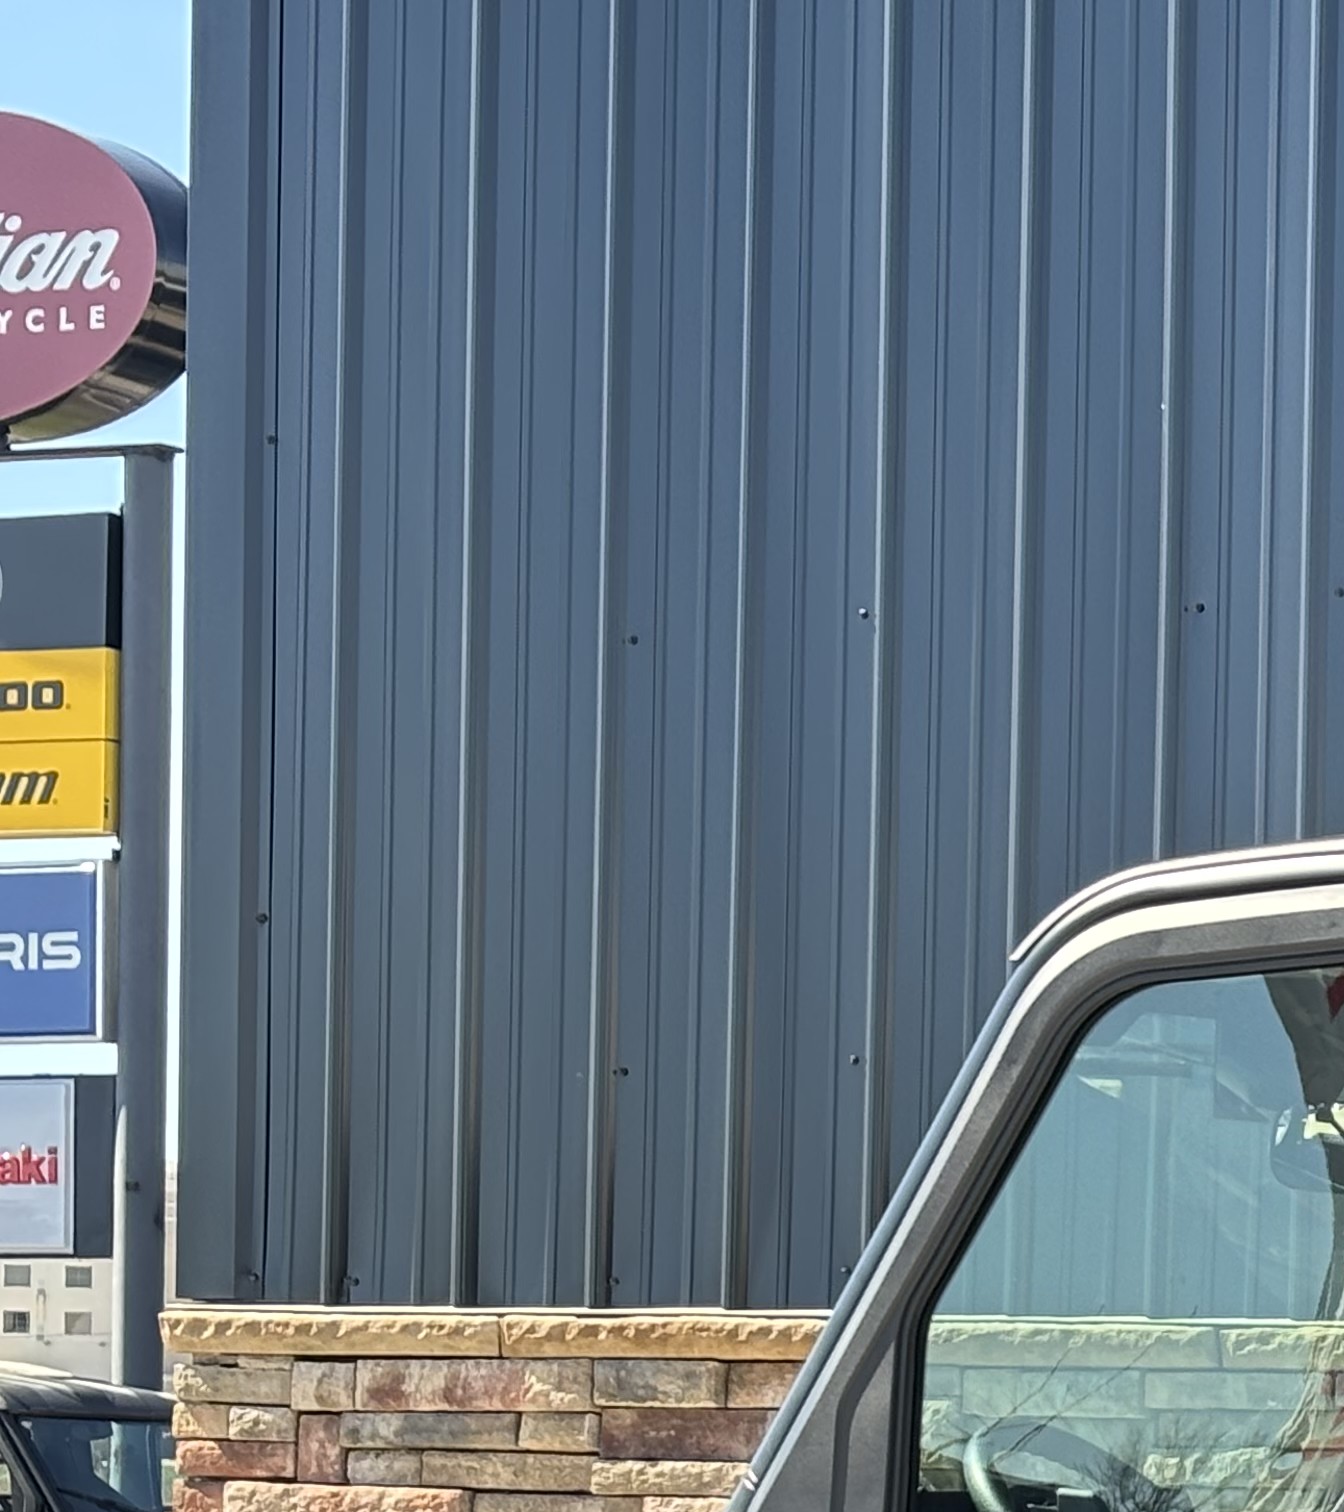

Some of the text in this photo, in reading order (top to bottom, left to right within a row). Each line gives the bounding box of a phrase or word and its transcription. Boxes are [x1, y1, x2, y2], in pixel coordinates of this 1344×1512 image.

[0, 213, 120, 294] ian
[0, 304, 105, 334] YCLE
[0, 931, 81, 971] RIS
[0, 1145, 58, 1185] aki
